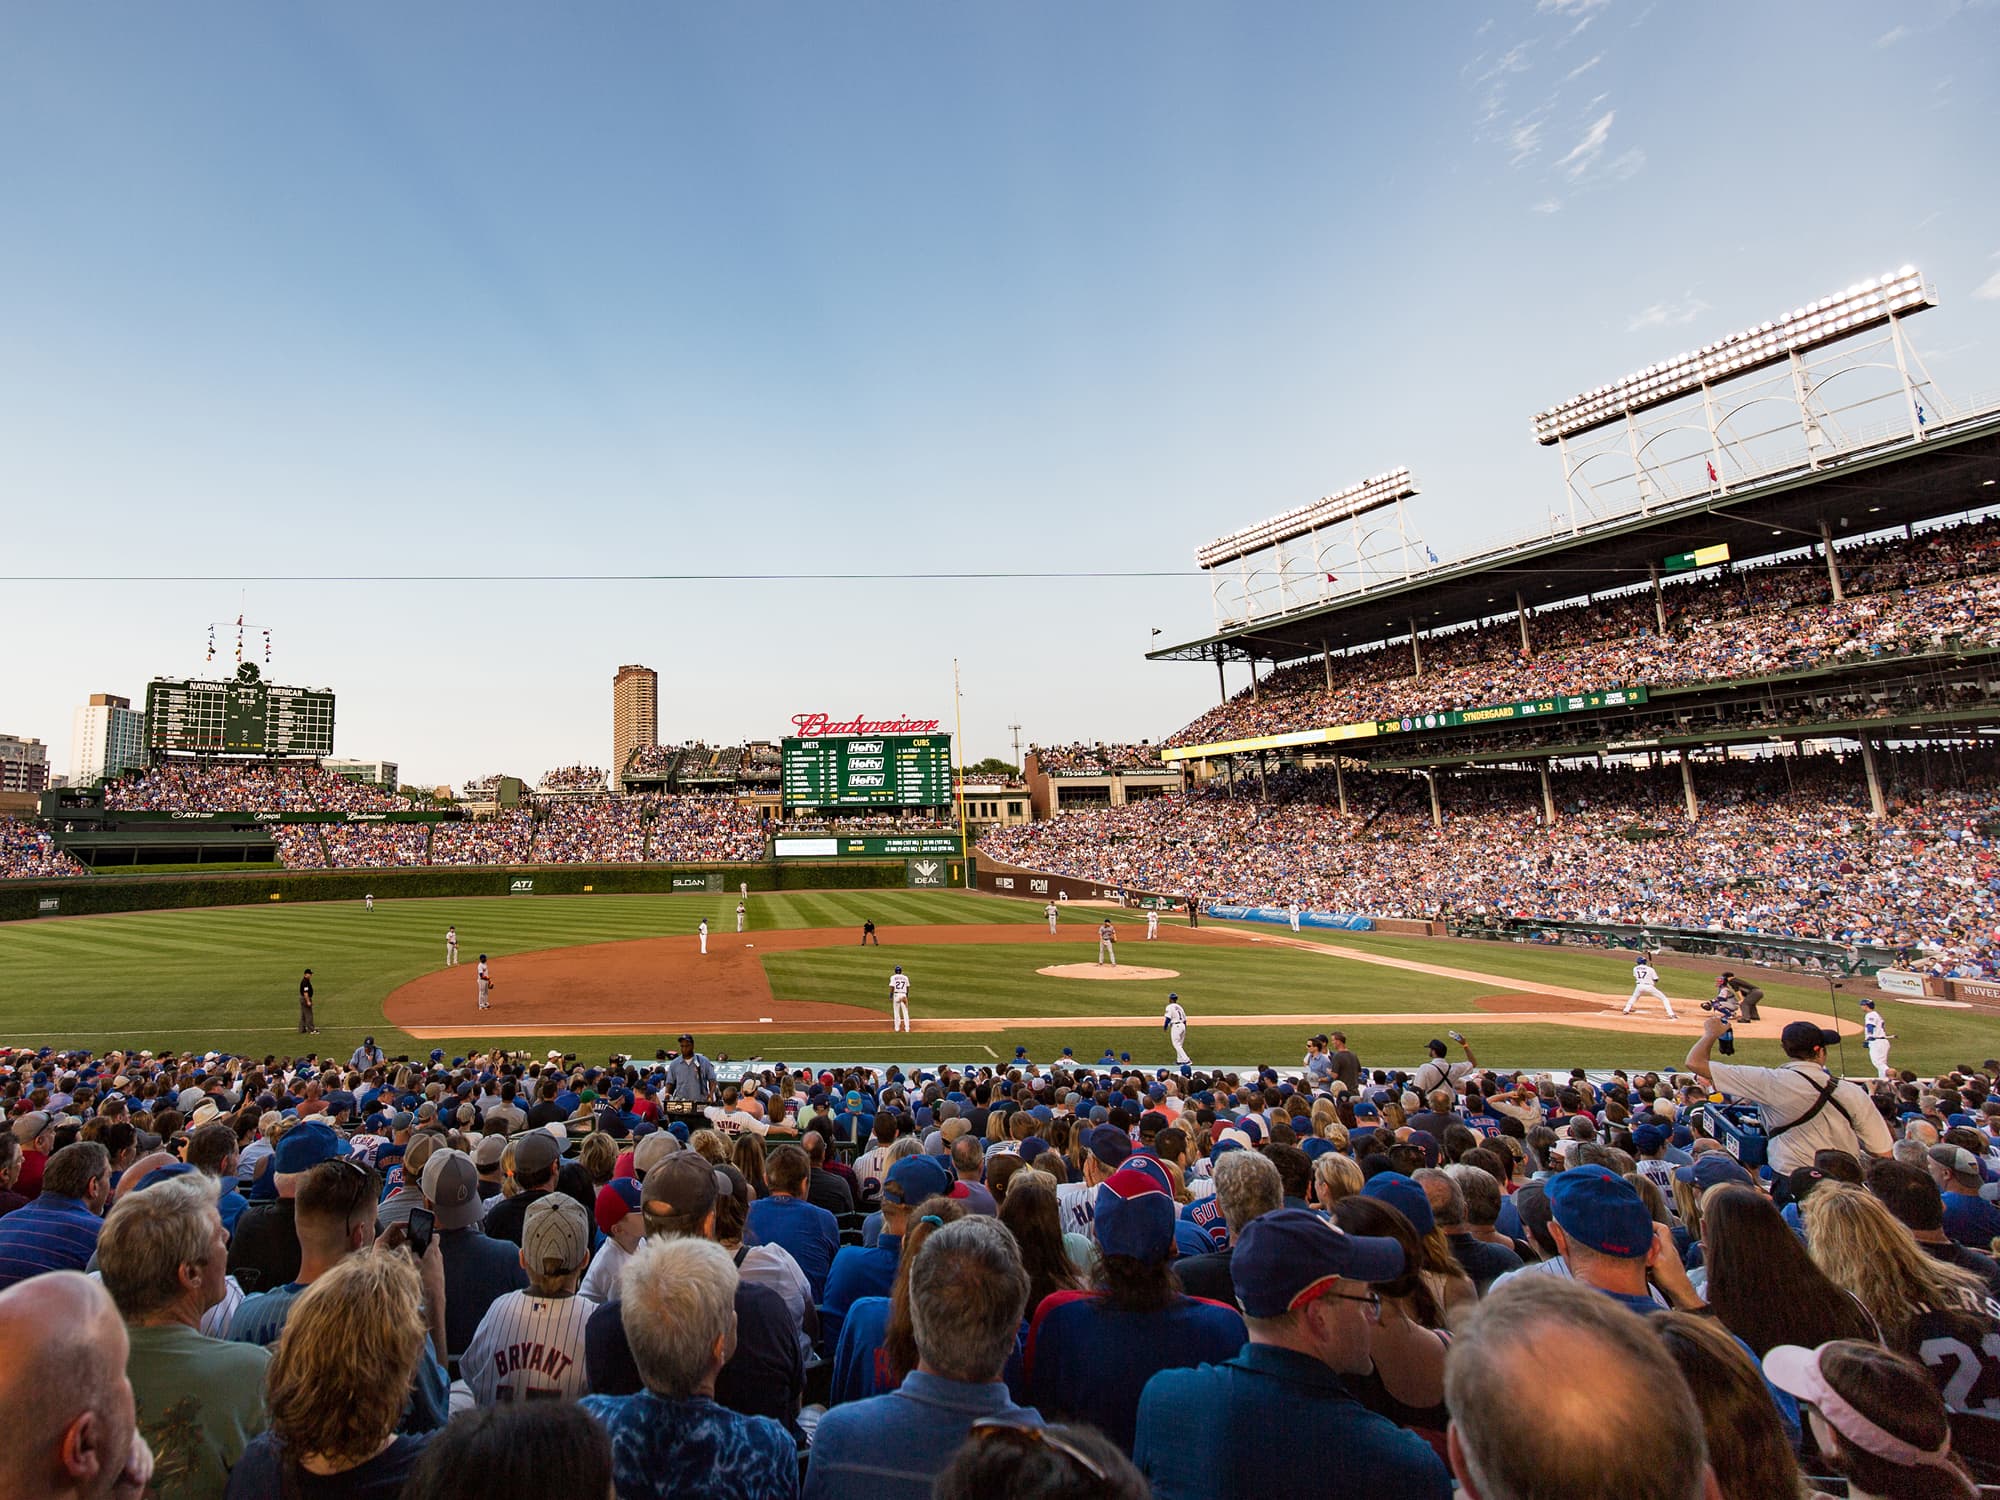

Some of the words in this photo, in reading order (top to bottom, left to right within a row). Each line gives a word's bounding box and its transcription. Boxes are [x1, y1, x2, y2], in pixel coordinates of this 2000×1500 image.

[189, 682, 228, 692] NATIONAL
[266, 688, 303, 697] AMERICAN
[1462, 707, 1514, 722] SYNDERGAARD
[1522, 705, 1536, 714] ERA
[791, 713, 939, 737] Budweiser
[802, 741, 820, 749] METS
[850, 743, 881, 753] Hefty
[912, 739, 930, 747] CUBS
[850, 759, 881, 769] Hefty
[851, 775, 882, 786] Hefty
[263, 812, 281, 821] pepsi
[346, 812, 387, 821] Budweiser
[511, 880, 533, 888] ATI
[1030, 879, 1048, 891] PCM
[1637, 970, 1647, 979] 17
[895, 980, 906, 990] 27
[716, 1120, 741, 1130] BRYANT
[493, 1342, 574, 1381] BRYANT
